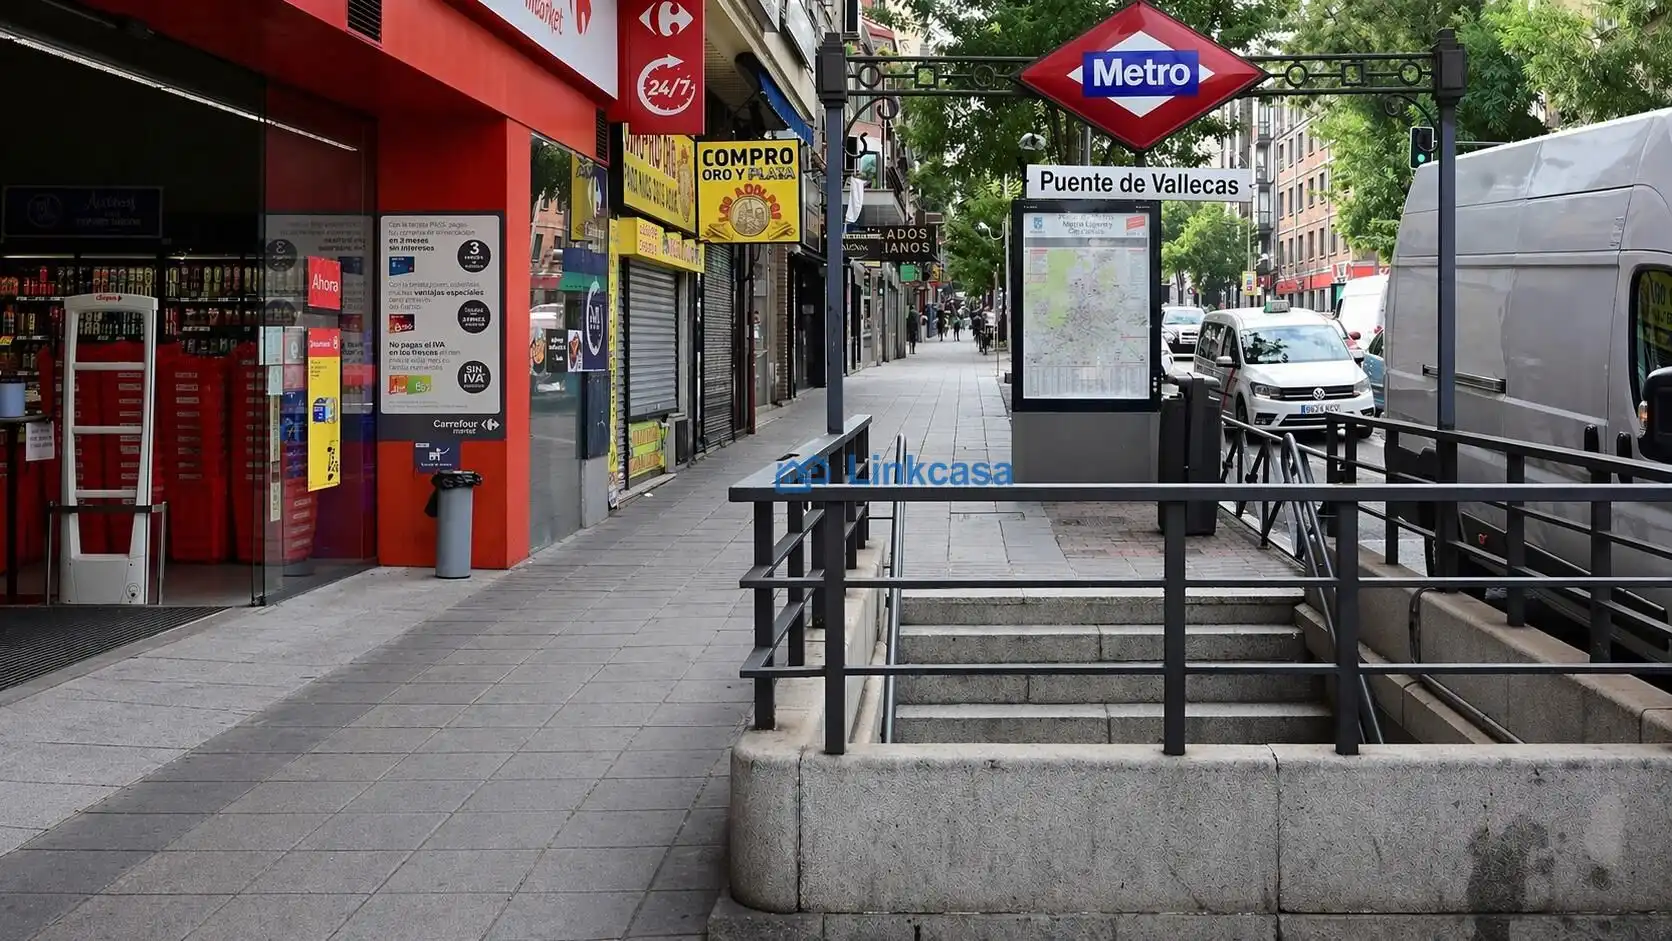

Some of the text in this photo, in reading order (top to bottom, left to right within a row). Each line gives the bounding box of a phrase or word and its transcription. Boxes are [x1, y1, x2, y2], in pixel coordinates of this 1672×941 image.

[1093, 58, 1191, 87] Metro
[647, 78, 691, 98] 24/7
[702, 147, 794, 167] COMPRO
[702, 168, 732, 181] ORO
[736, 168, 745, 180] Y
[1040, 170, 1239, 195] Puente de Vallecas
[886, 228, 928, 240] ADOS
[470, 241, 480, 255] 3
[883, 242, 930, 254] IANOS
[312, 274, 339, 292] Ahora
[414, 289, 445, 297] ventajas
[446, 288, 485, 297] especiales
[466, 365, 482, 373] SIN
[433, 419, 478, 428] Carrefour
